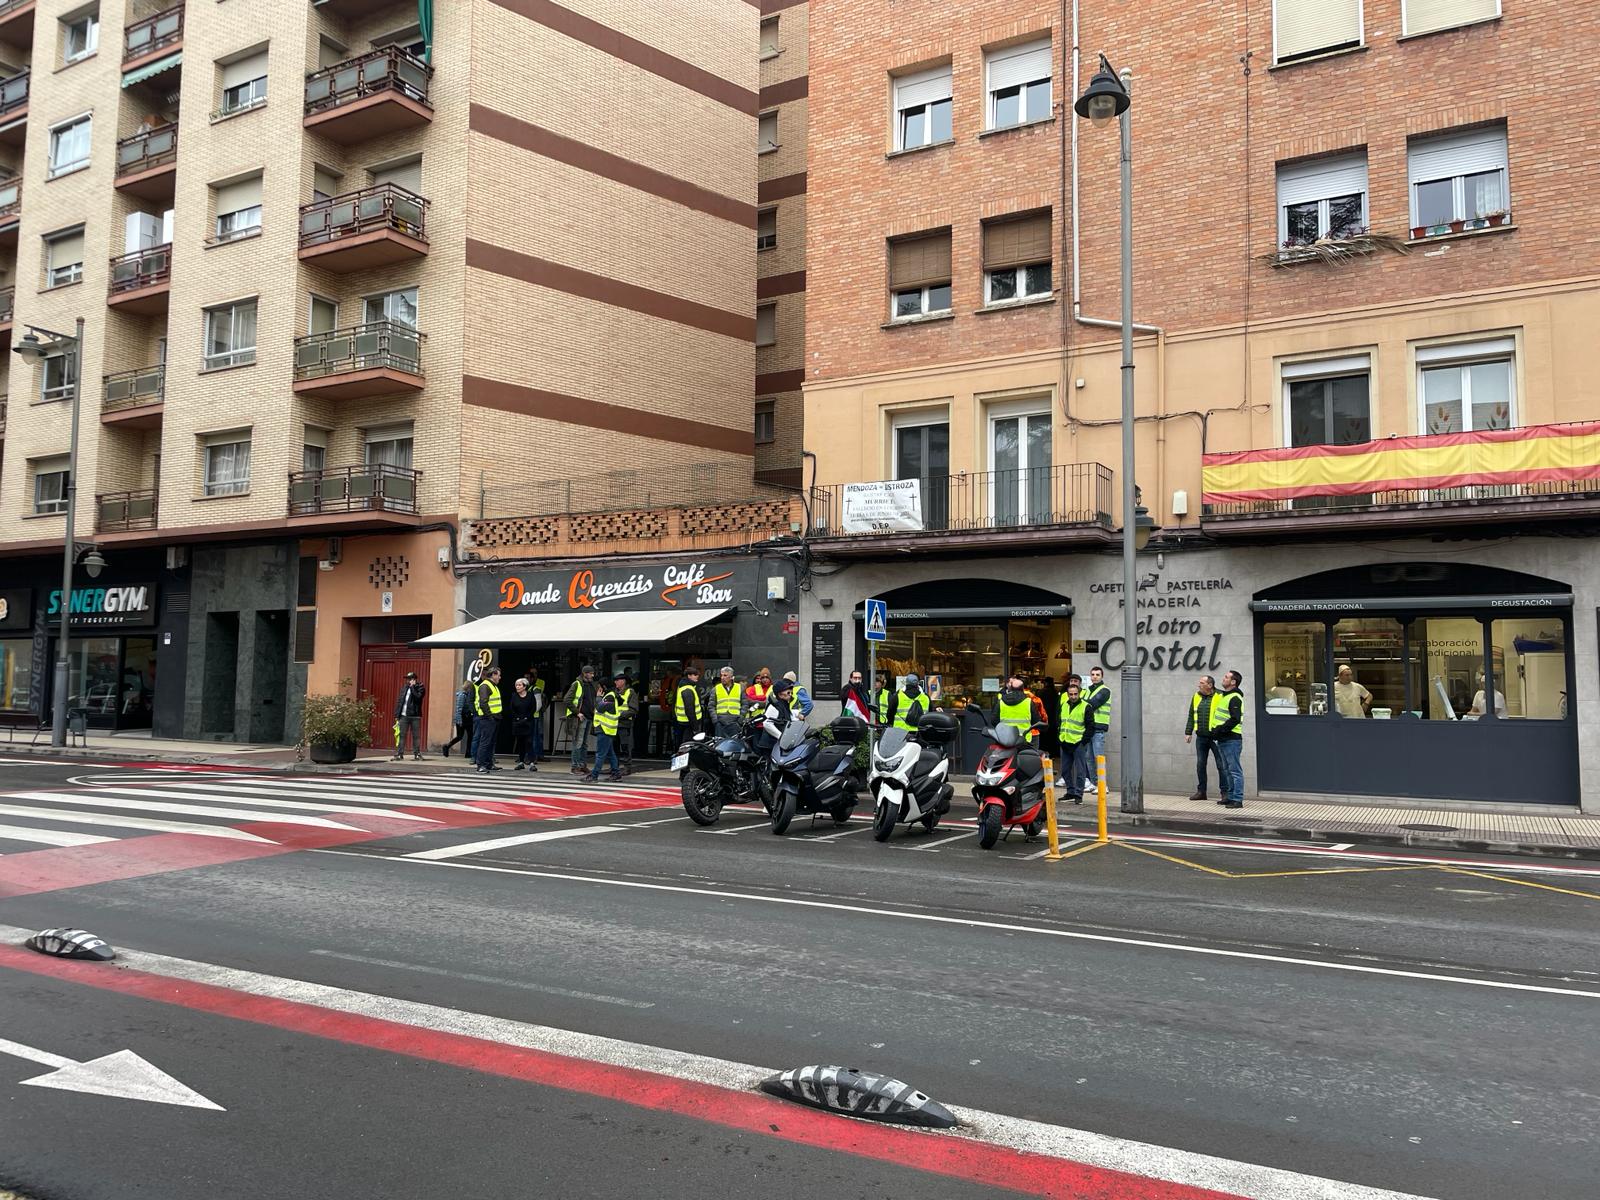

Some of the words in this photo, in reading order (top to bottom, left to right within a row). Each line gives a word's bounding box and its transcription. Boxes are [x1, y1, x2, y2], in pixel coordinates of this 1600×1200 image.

[663, 563, 706, 589] Café
[499, 577, 561, 609] Donde
[568, 569, 654, 609] Queráis
[1167, 577, 1233, 591] PASTELERÍA
[696, 583, 733, 604] Bar
[1118, 595, 1201, 609] PNADERÍA
[1268, 603, 1311, 611] PANADERÍA
[1491, 598, 1552, 607] DEGUSTACIÓN
[1011, 609, 1054, 617] DEGUSTACIÓN
[1136, 614, 1153, 635] el
[1158, 617, 1201, 634] otro
[1415, 637, 1478, 647] aboración
[1100, 633, 1222, 671] Costal
[1419, 648, 1475, 657] adicional
